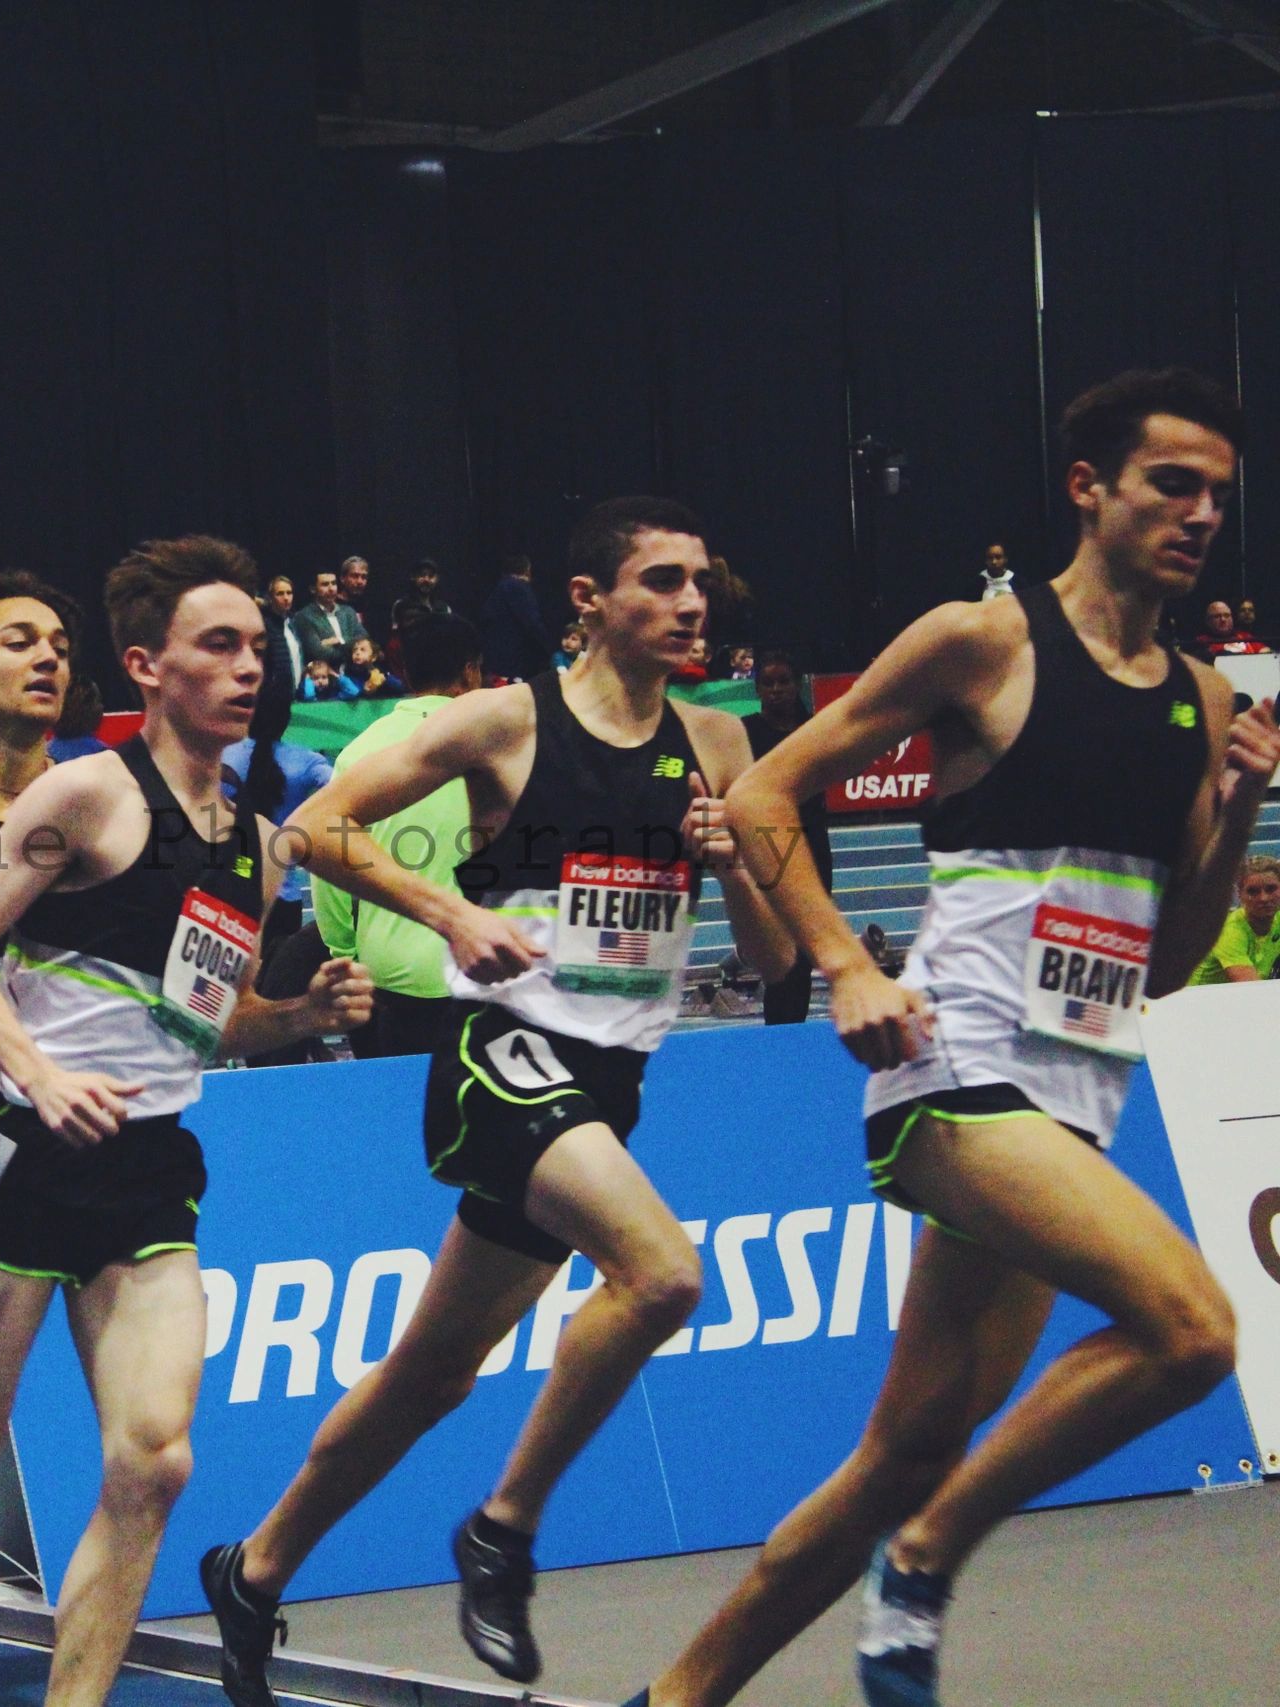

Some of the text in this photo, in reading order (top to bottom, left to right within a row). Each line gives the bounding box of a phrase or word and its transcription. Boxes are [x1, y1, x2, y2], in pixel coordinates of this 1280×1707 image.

[844, 773, 931, 800] USATF
[569, 864, 686, 886] new balance
[568, 887, 682, 933] FLEURY
